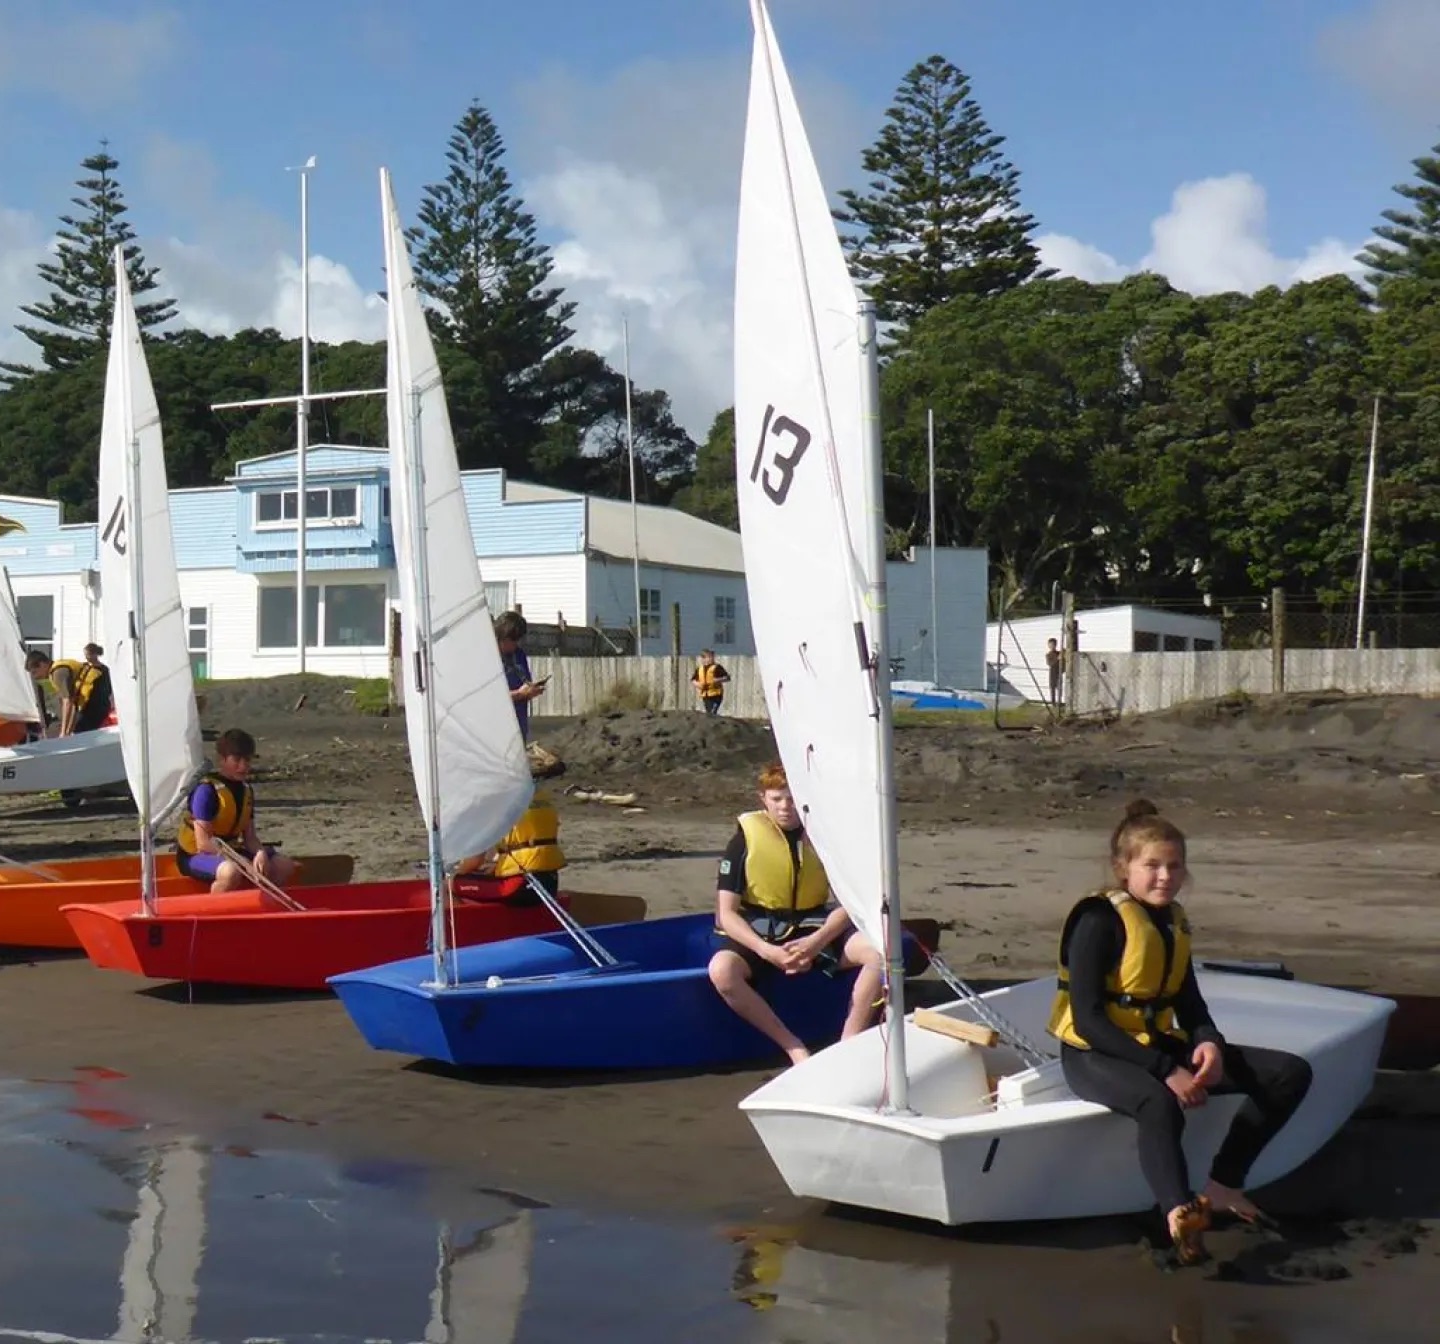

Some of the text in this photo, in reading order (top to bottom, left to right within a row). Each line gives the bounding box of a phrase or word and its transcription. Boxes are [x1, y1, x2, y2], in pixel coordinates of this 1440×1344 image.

[751, 404, 811, 506] 13
[2, 765, 17, 780] 16
[982, 1137, 1000, 1173] 1
